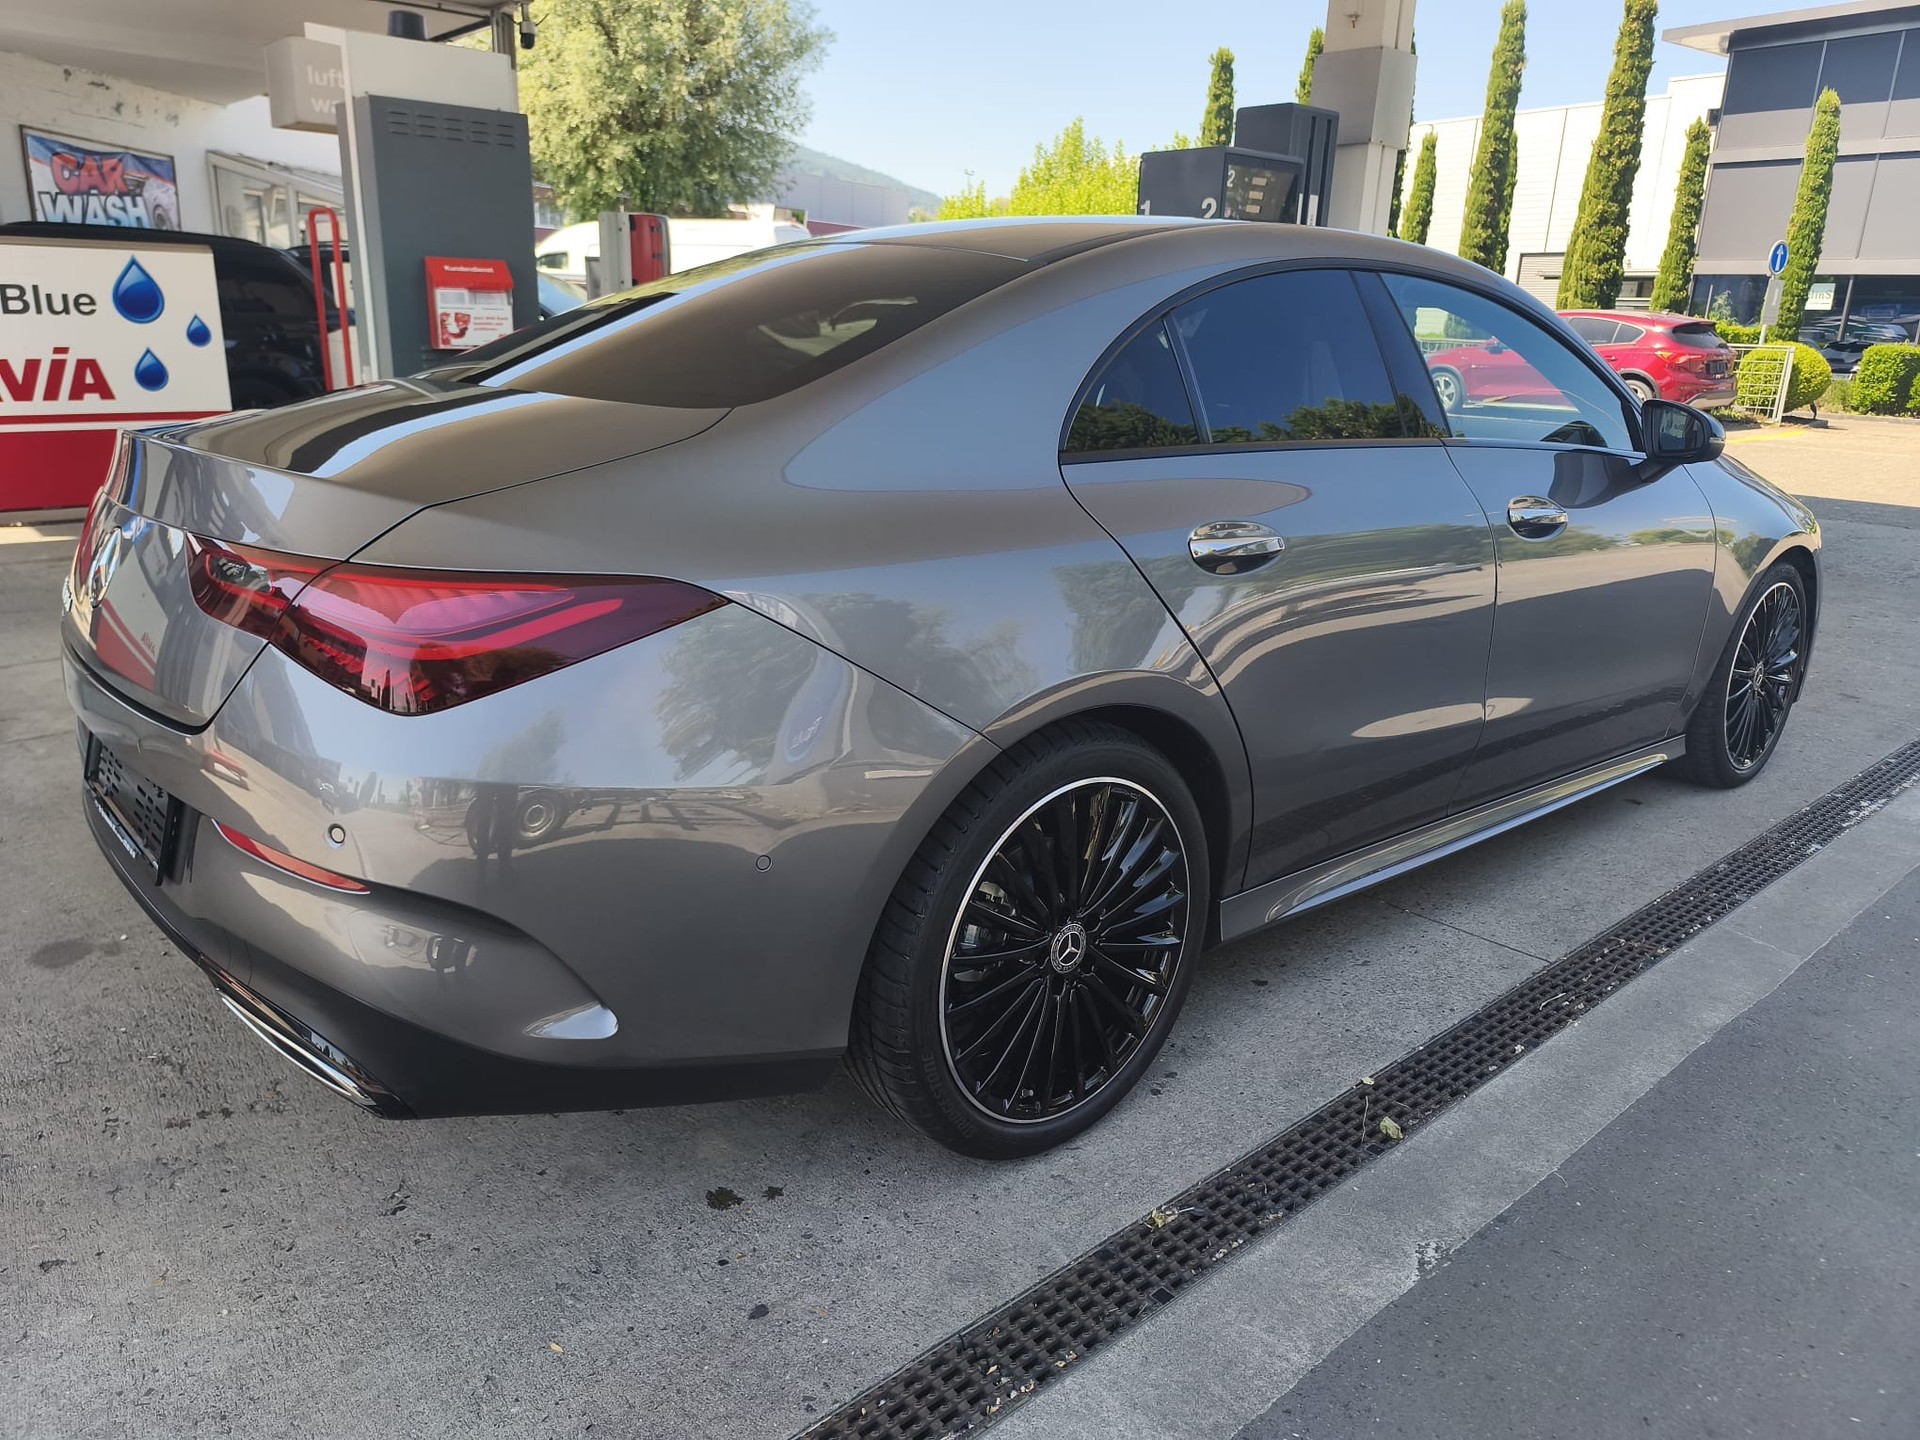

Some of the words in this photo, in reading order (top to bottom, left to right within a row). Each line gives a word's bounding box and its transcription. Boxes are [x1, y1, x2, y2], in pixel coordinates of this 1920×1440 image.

[51, 152, 128, 194] CAR
[1227, 169, 1235, 187] 2
[38, 191, 150, 229] WASH
[1140, 200, 1151, 216] 1
[1201, 197, 1217, 219] 2
[0, 284, 97, 315] Blue
